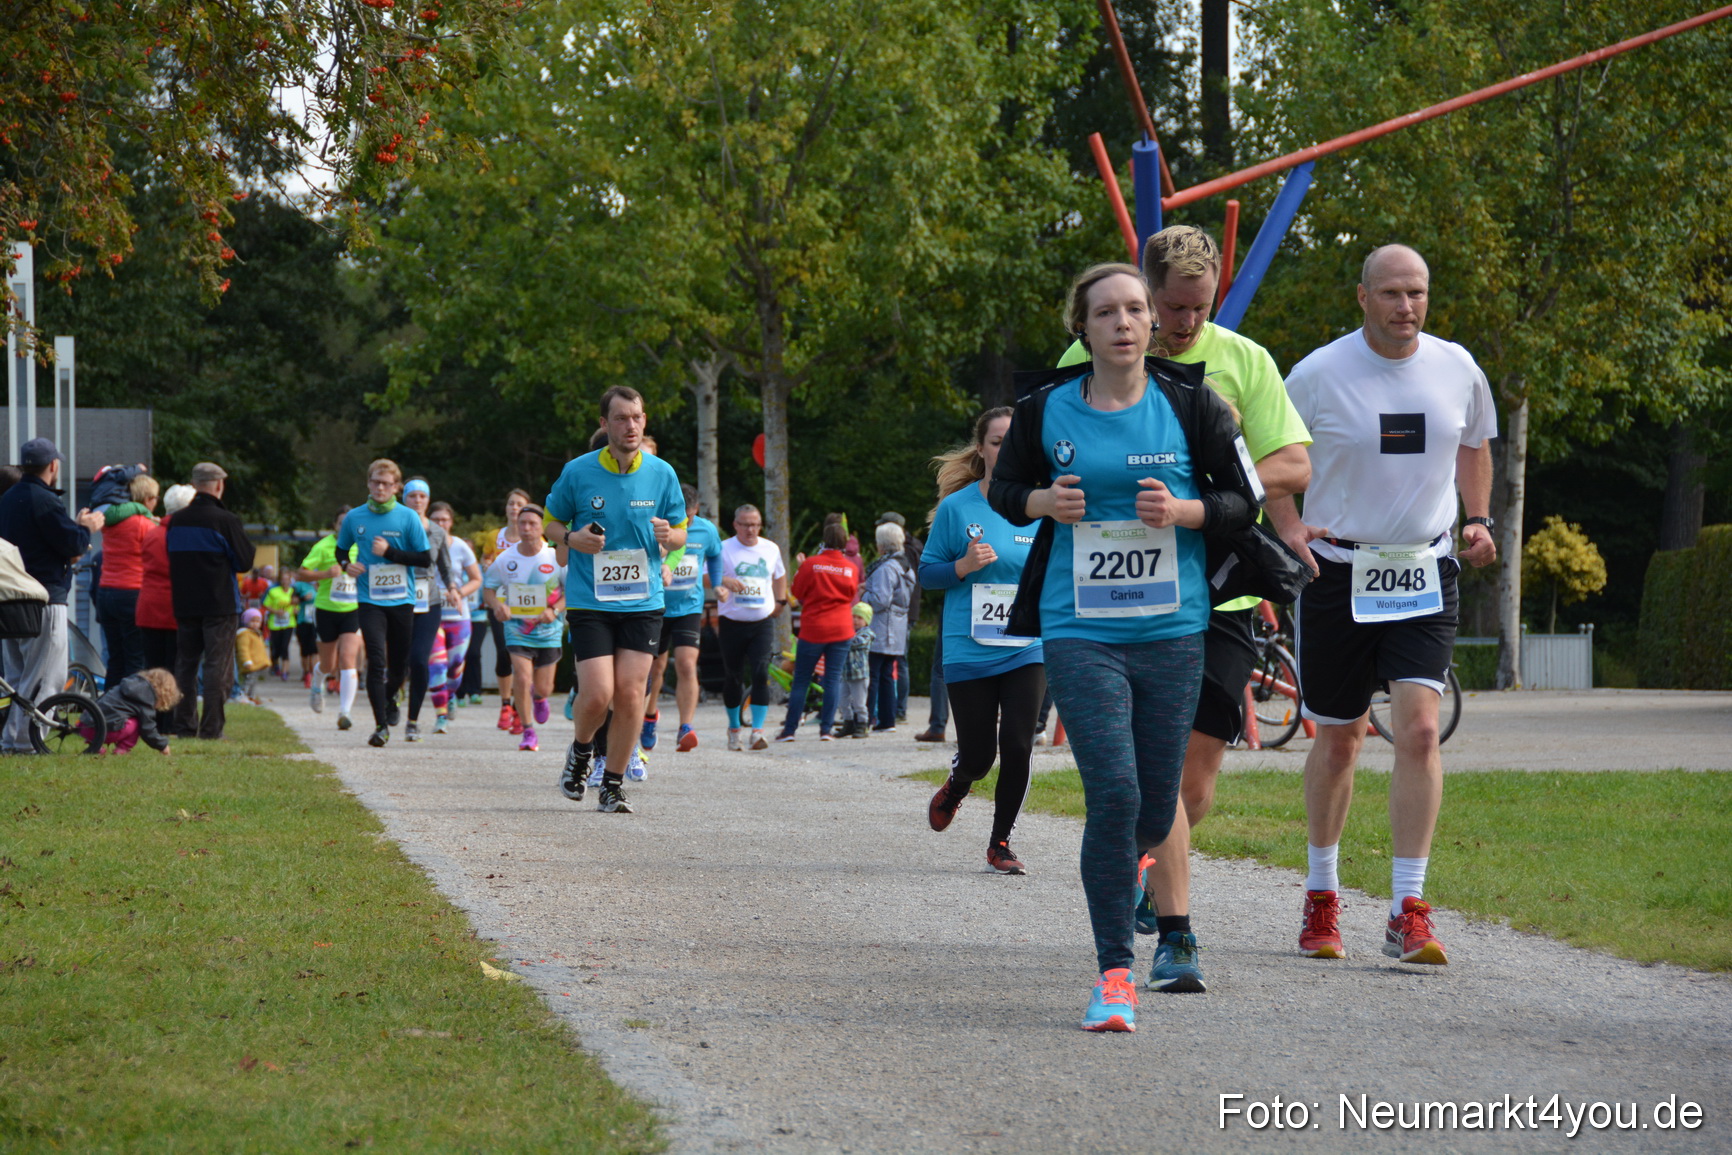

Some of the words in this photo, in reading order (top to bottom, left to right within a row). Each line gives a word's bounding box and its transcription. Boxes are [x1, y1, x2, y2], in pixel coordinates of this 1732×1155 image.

[1126, 452, 1177, 465] BOCK
[630, 499, 655, 507] BOCK
[1014, 535, 1035, 544] BO
[1089, 548, 1162, 580] 2207
[602, 564, 640, 582] 2373
[673, 565, 693, 577] 487
[374, 574, 402, 586] 2233
[1365, 567, 1427, 592] 2048
[613, 584, 631, 592] Tobias
[517, 595, 536, 606] 161
[1110, 588, 1145, 601] Carina
[1376, 600, 1418, 609] Wolfgang
